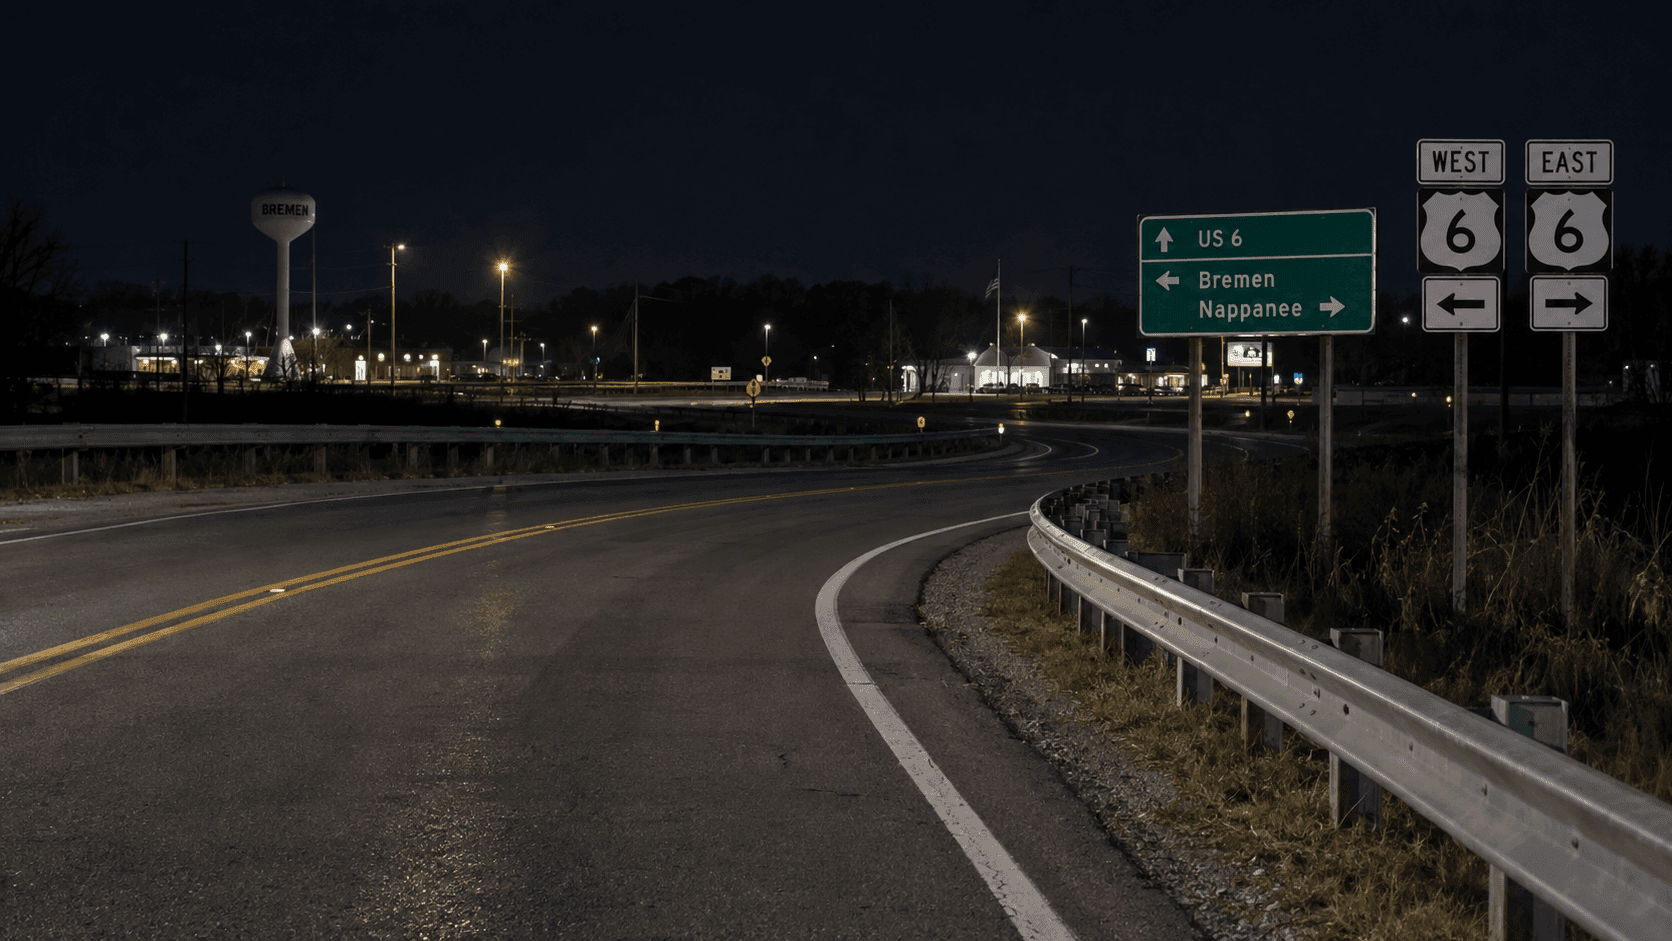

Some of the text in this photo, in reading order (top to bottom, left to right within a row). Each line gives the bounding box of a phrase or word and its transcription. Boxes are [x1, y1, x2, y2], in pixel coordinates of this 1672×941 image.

[1432, 151, 1489, 173] WEST
[1542, 151, 1598, 173] EAST
[262, 203, 309, 216] BREMEN
[1198, 229, 1243, 248] US 6
[1446, 208, 1476, 254] 6
[1554, 208, 1584, 254] 6
[1199, 271, 1276, 289] Bremen
[1199, 300, 1303, 323] Nappanee
